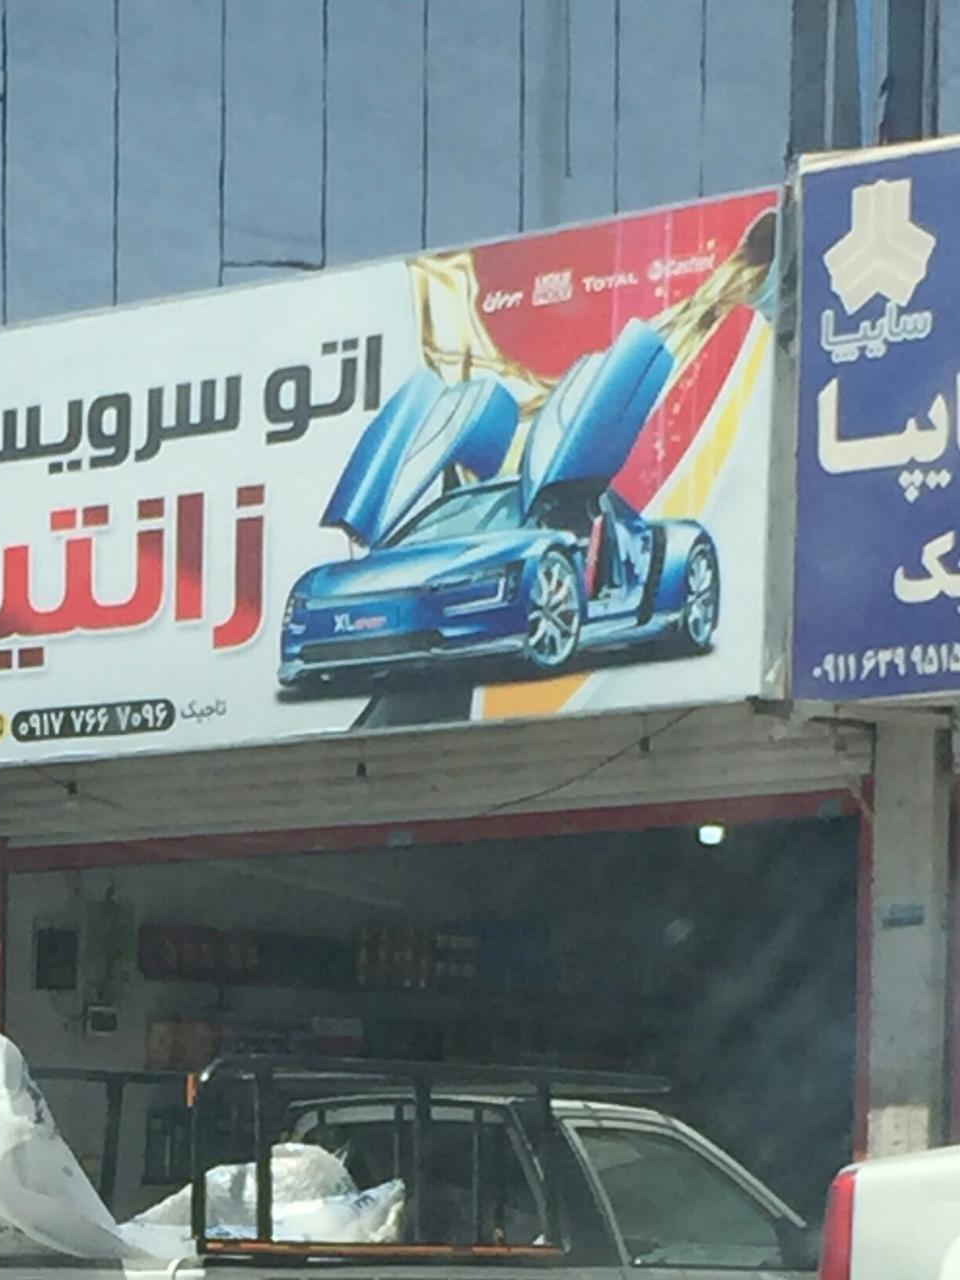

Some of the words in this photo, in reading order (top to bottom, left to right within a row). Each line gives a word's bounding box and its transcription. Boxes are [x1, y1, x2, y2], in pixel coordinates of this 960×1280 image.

[582, 271, 639, 293] TOTAL
[264, 334, 383, 445] اتو
[18, 711, 65, 737] ۰۹۱۷
[70, 708, 111, 734] ۷۶۶
[116, 703, 169, 731] ۷۰۹۶
[180, 698, 228, 725] تاجیک
